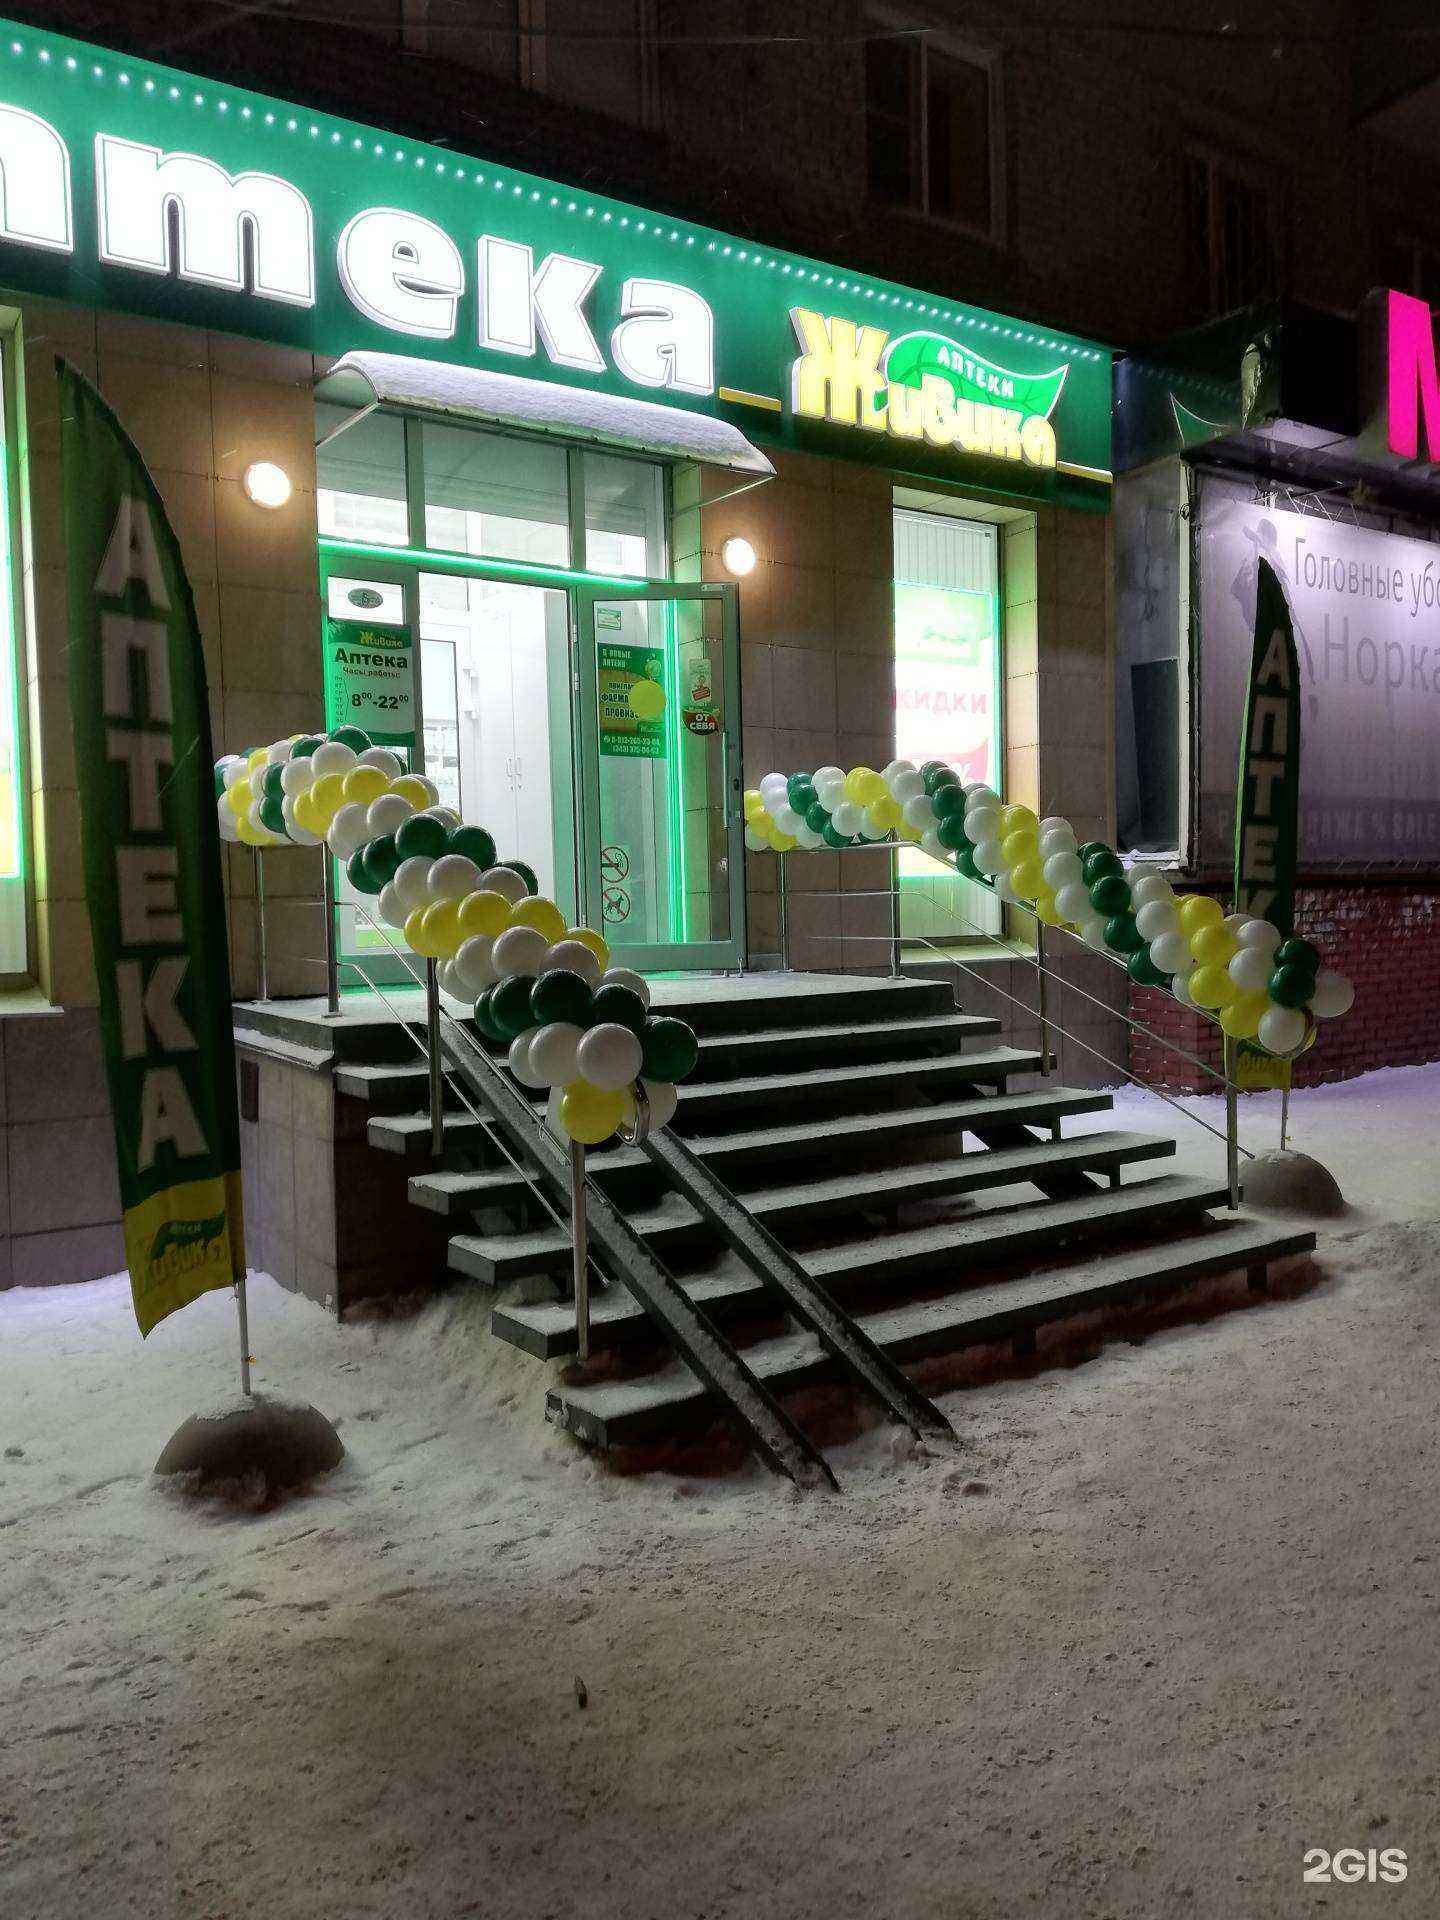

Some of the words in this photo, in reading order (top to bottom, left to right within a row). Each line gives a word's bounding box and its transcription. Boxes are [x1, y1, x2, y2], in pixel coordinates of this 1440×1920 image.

[937, 345, 1015, 399] АПТЕКИ
[1294, 535, 1405, 603] Головные
[334, 647, 409, 669] Аптека
[343, 666, 366, 677] Часы
[689, 721, 715, 730] СЕБЯ
[695, 713, 709, 722] ОТ
[1240, 626, 1293, 922] АПТЕК
[91, 488, 211, 1174] АПТЕКА
